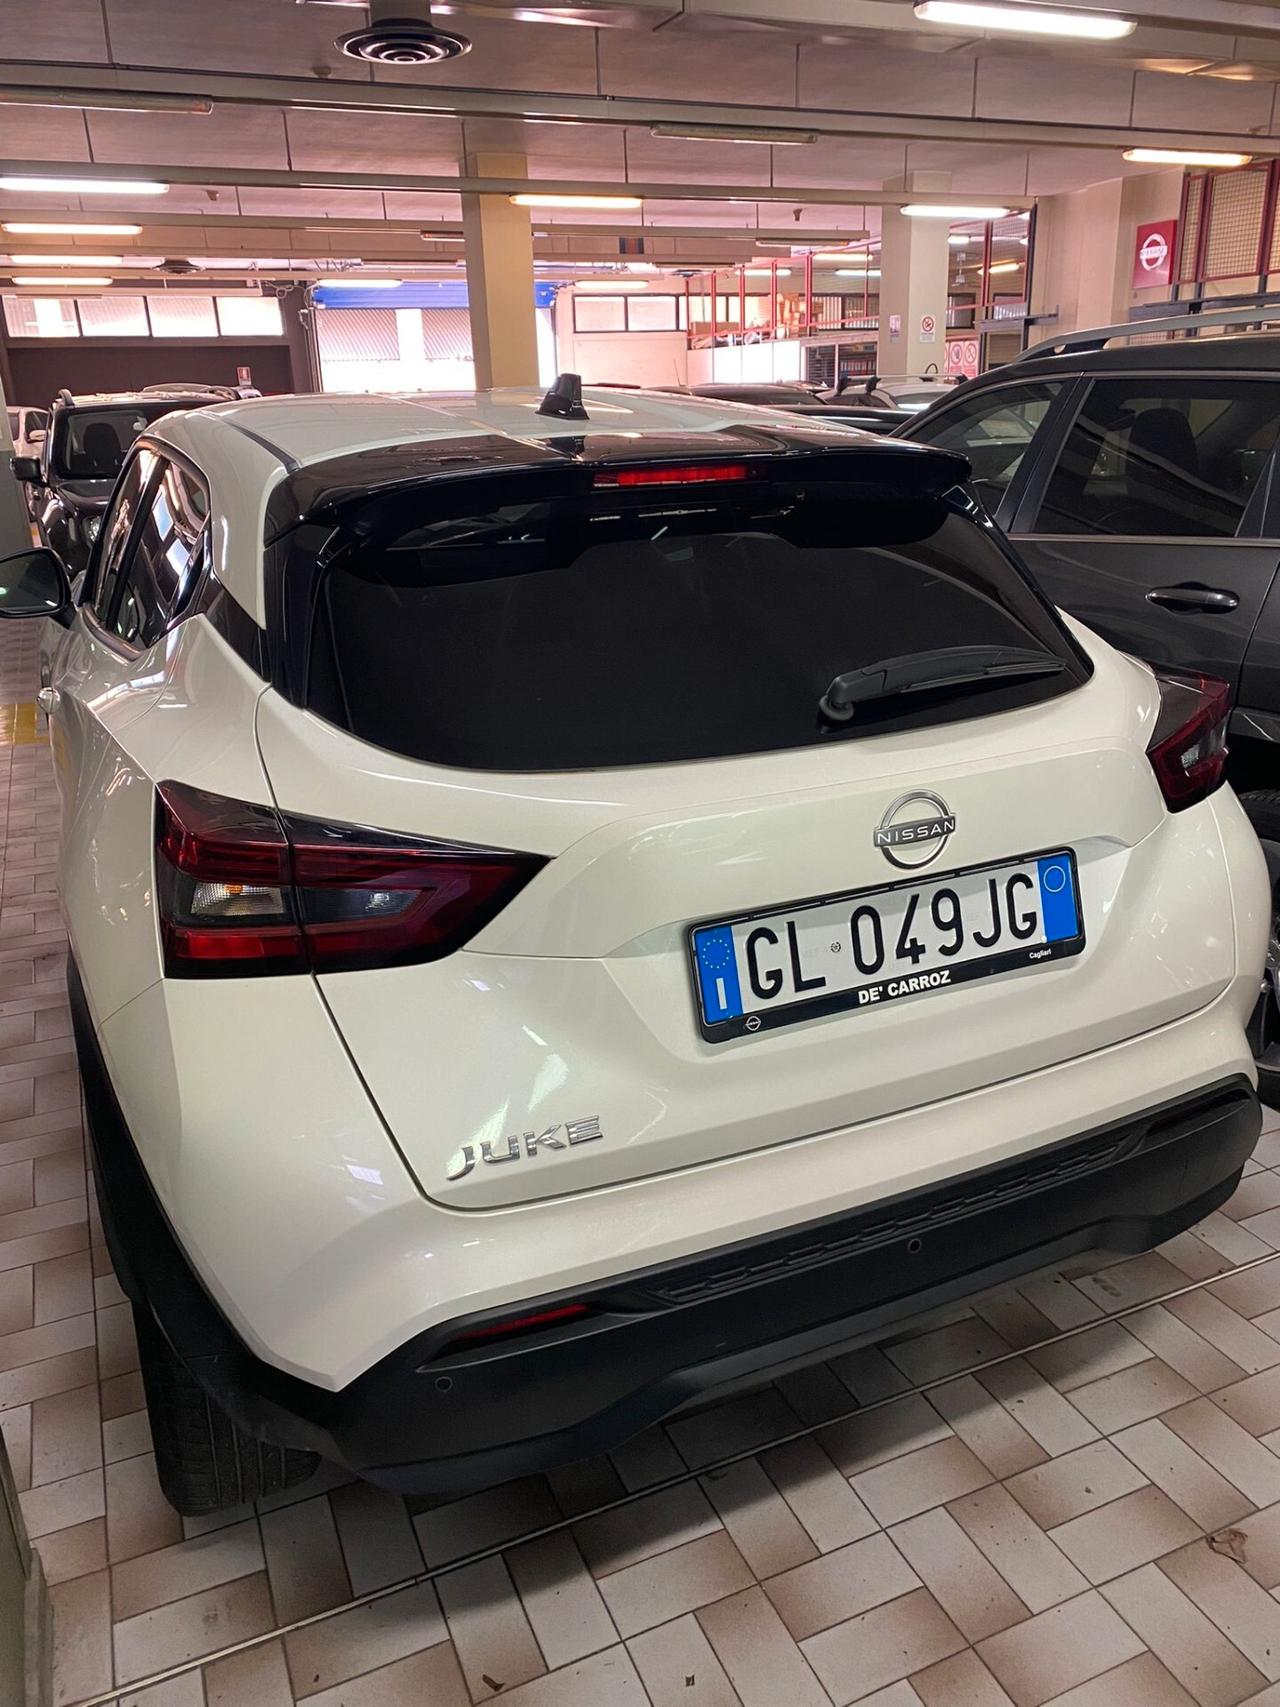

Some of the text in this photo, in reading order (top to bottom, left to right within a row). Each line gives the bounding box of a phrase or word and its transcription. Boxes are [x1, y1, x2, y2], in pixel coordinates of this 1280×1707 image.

[877, 819, 955, 844] NISSAN
[746, 920, 826, 999] GL
[715, 977, 729, 1010] I
[858, 970, 951, 1004] DE' CARROZ
[446, 1115, 603, 1180] JUKE
